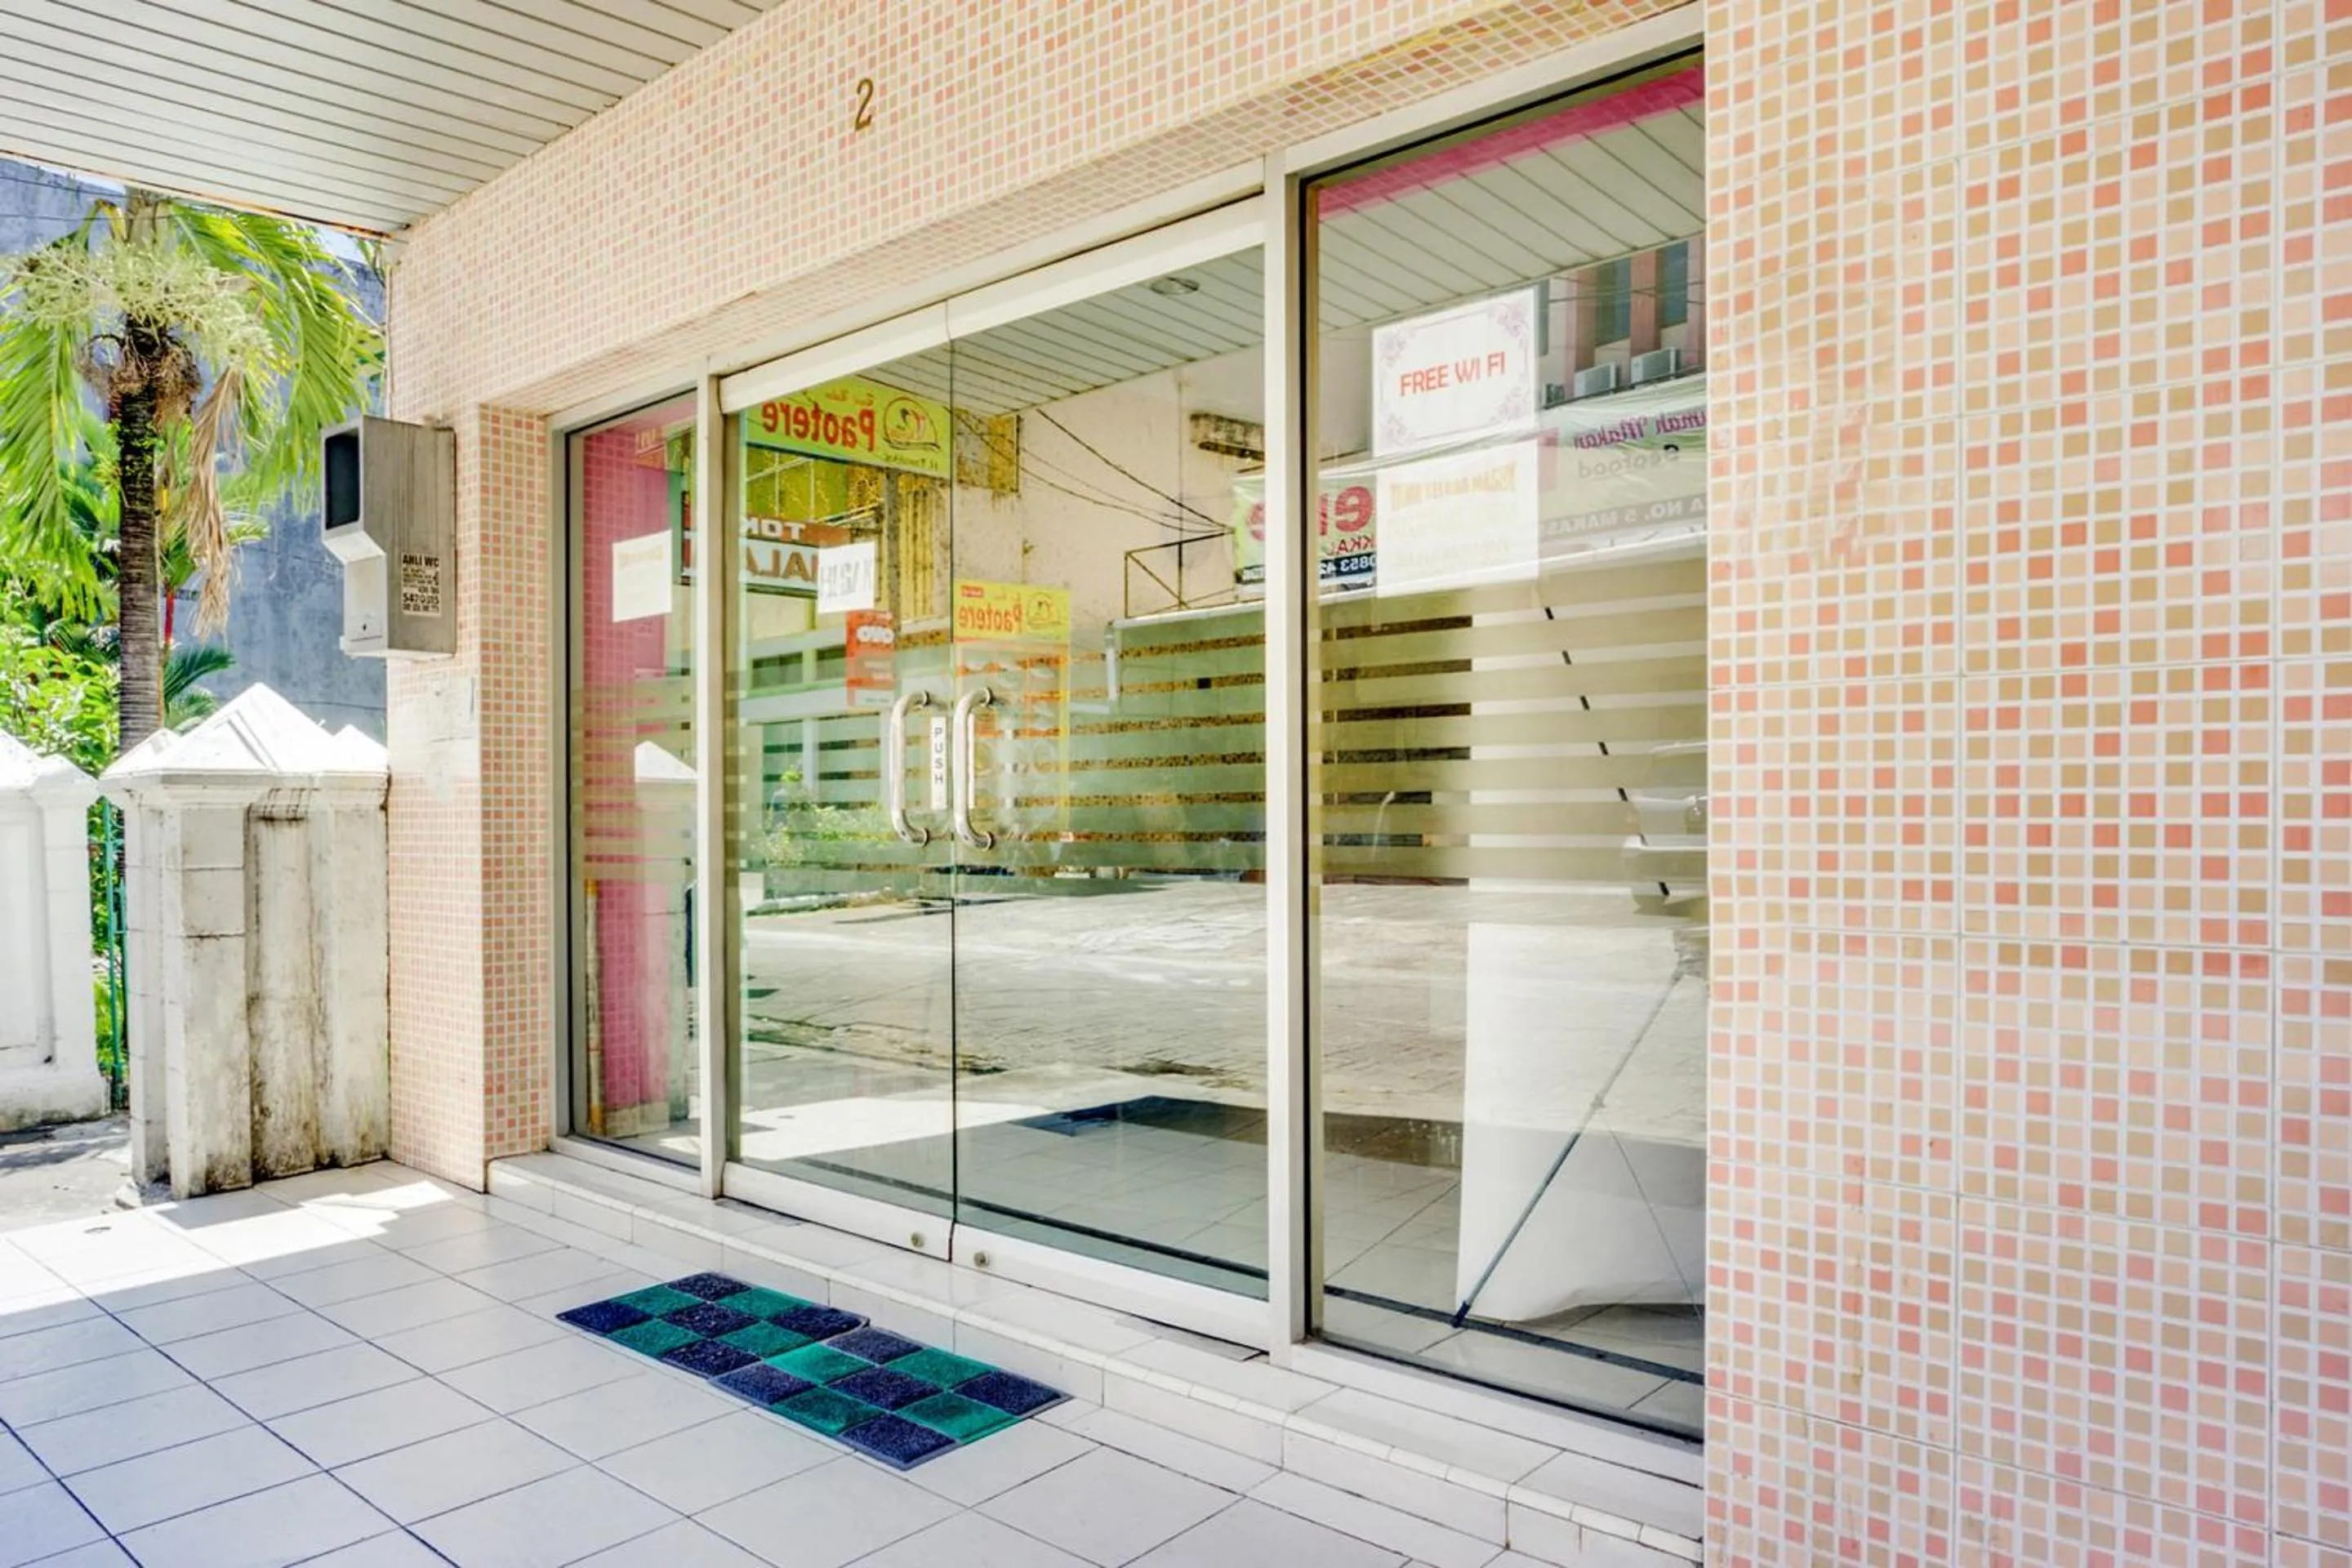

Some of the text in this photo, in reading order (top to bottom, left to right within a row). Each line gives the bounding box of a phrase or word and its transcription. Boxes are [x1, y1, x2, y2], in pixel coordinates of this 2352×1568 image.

[854, 78, 873, 131] 2
[1400, 351, 1505, 397] FREE WI FI
[933, 727, 943, 785] PUSH
